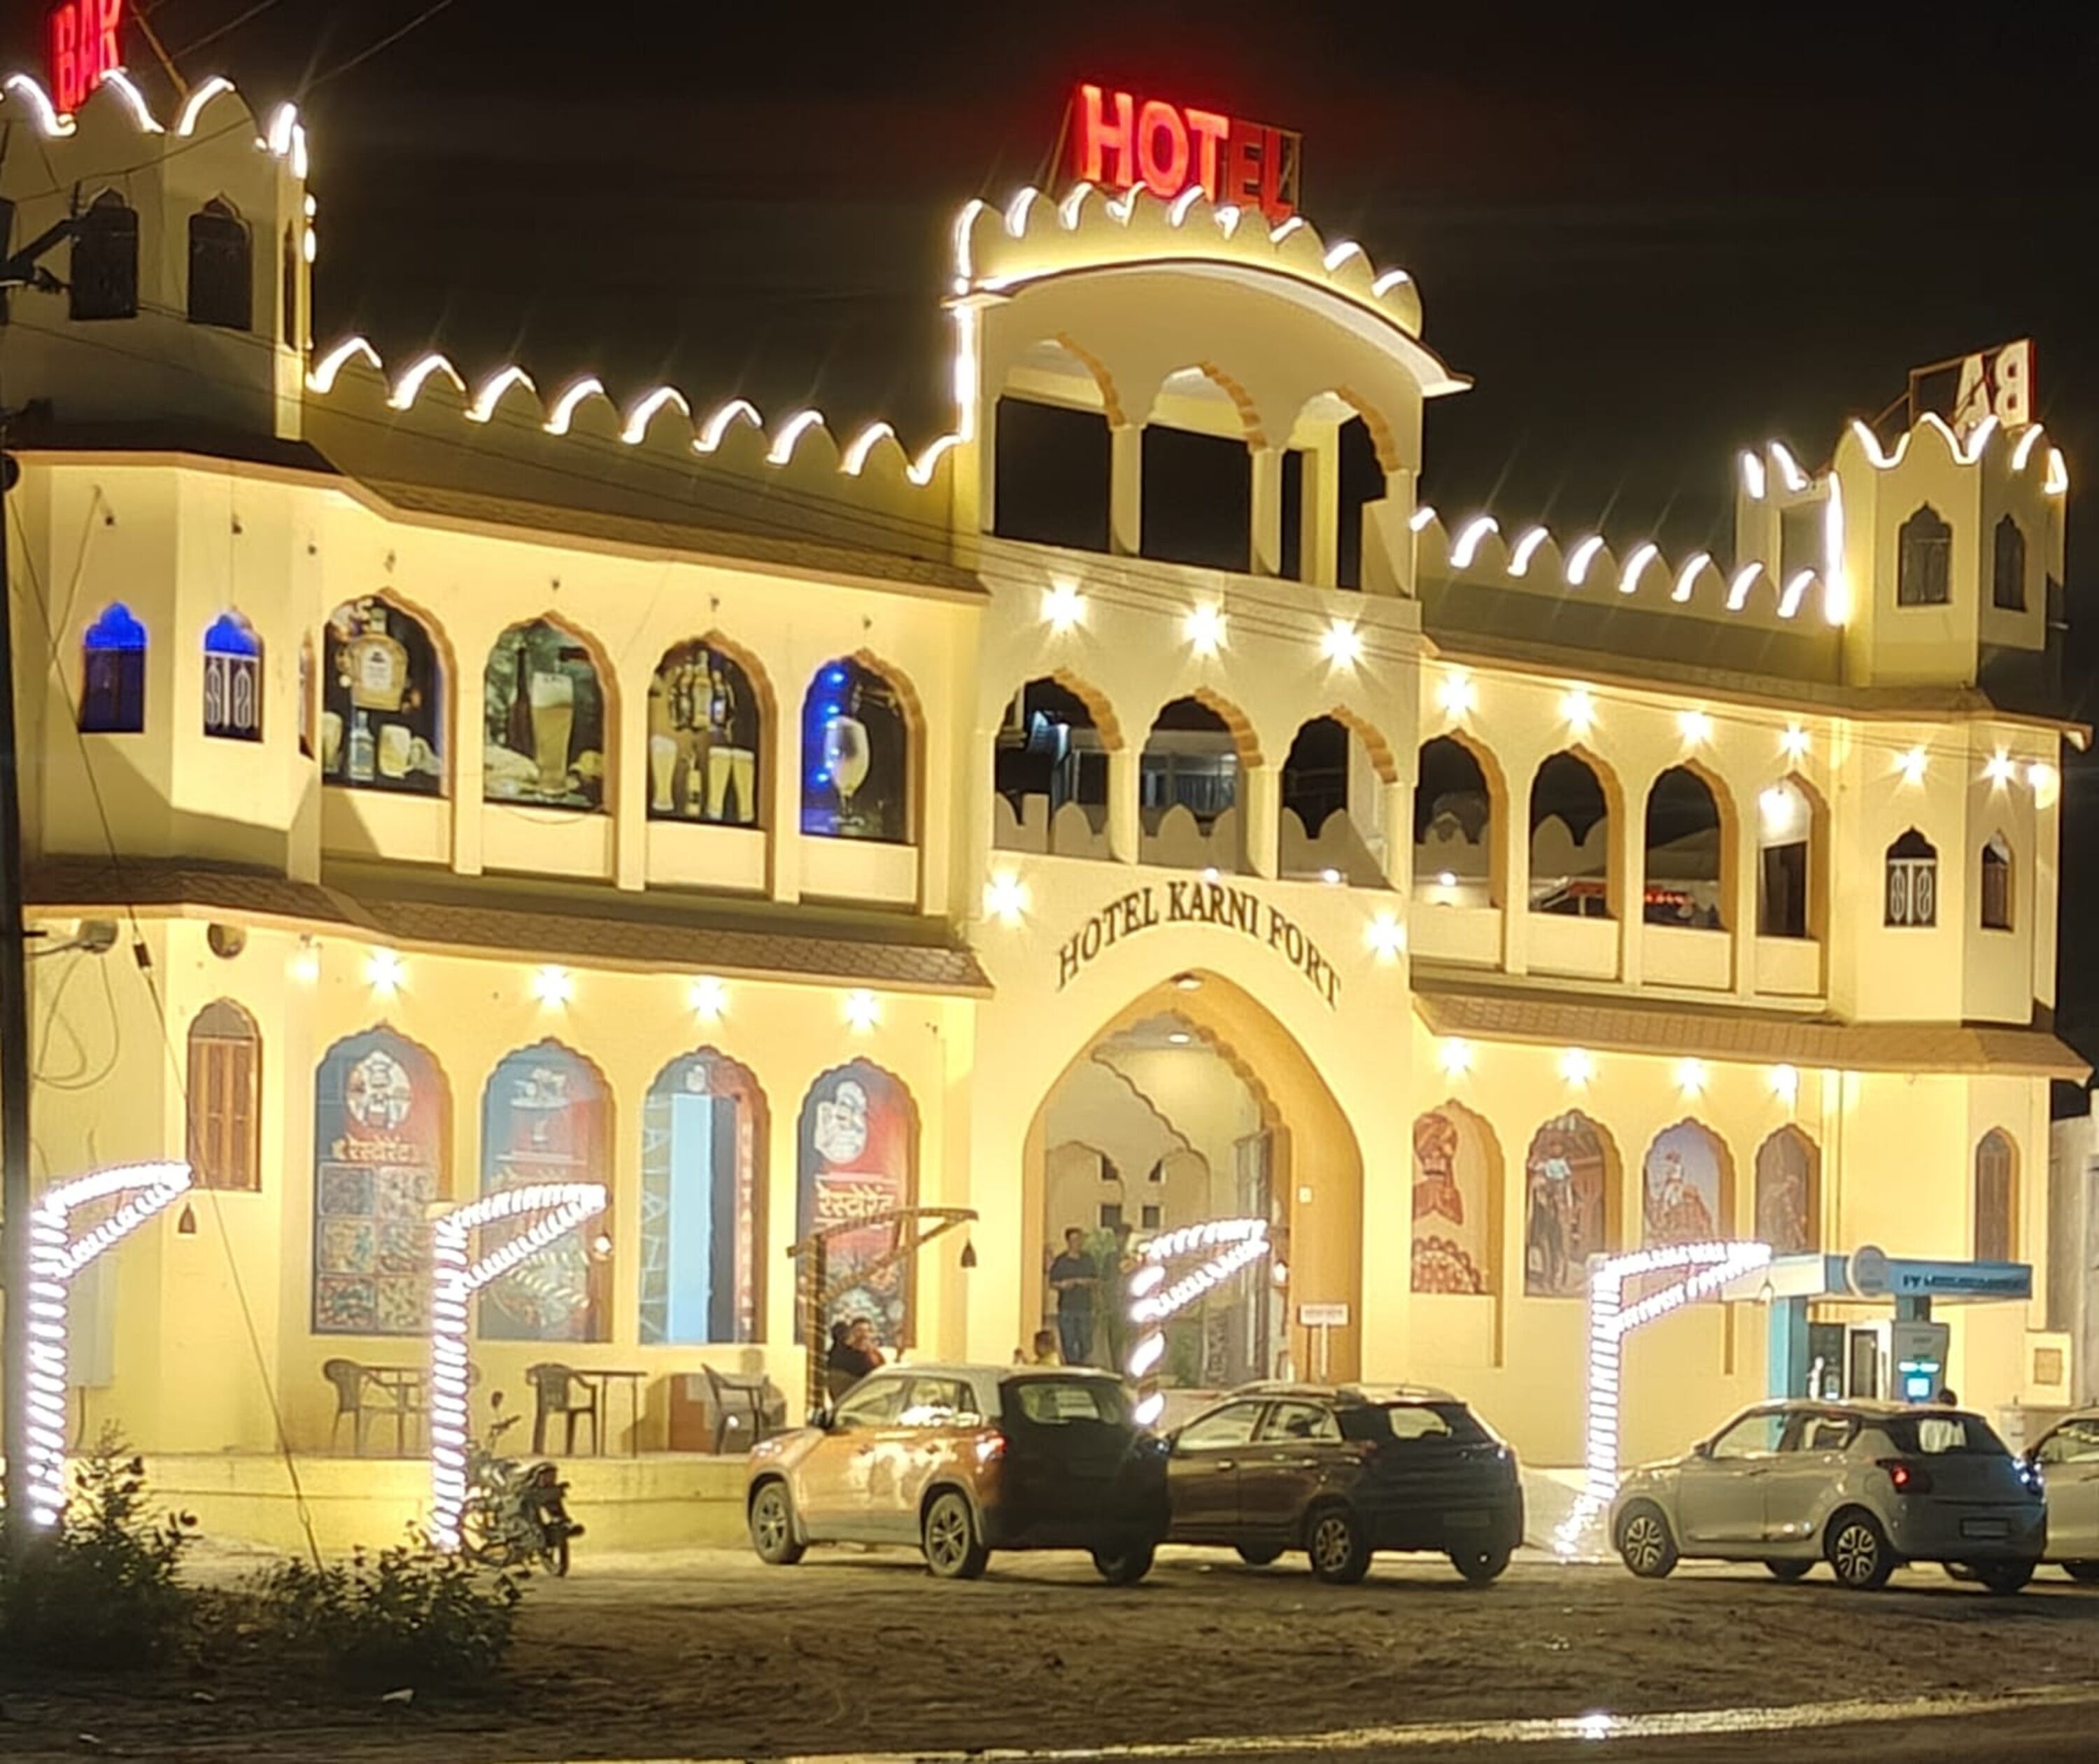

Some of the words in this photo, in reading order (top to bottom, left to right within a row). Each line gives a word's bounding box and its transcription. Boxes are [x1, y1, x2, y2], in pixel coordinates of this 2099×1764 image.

[1082, 84, 1294, 223] HOTEL
[1056, 887, 1159, 992] HOTEL
[1166, 880, 1259, 939] KARNI
[1267, 904, 1341, 1012] FORT
